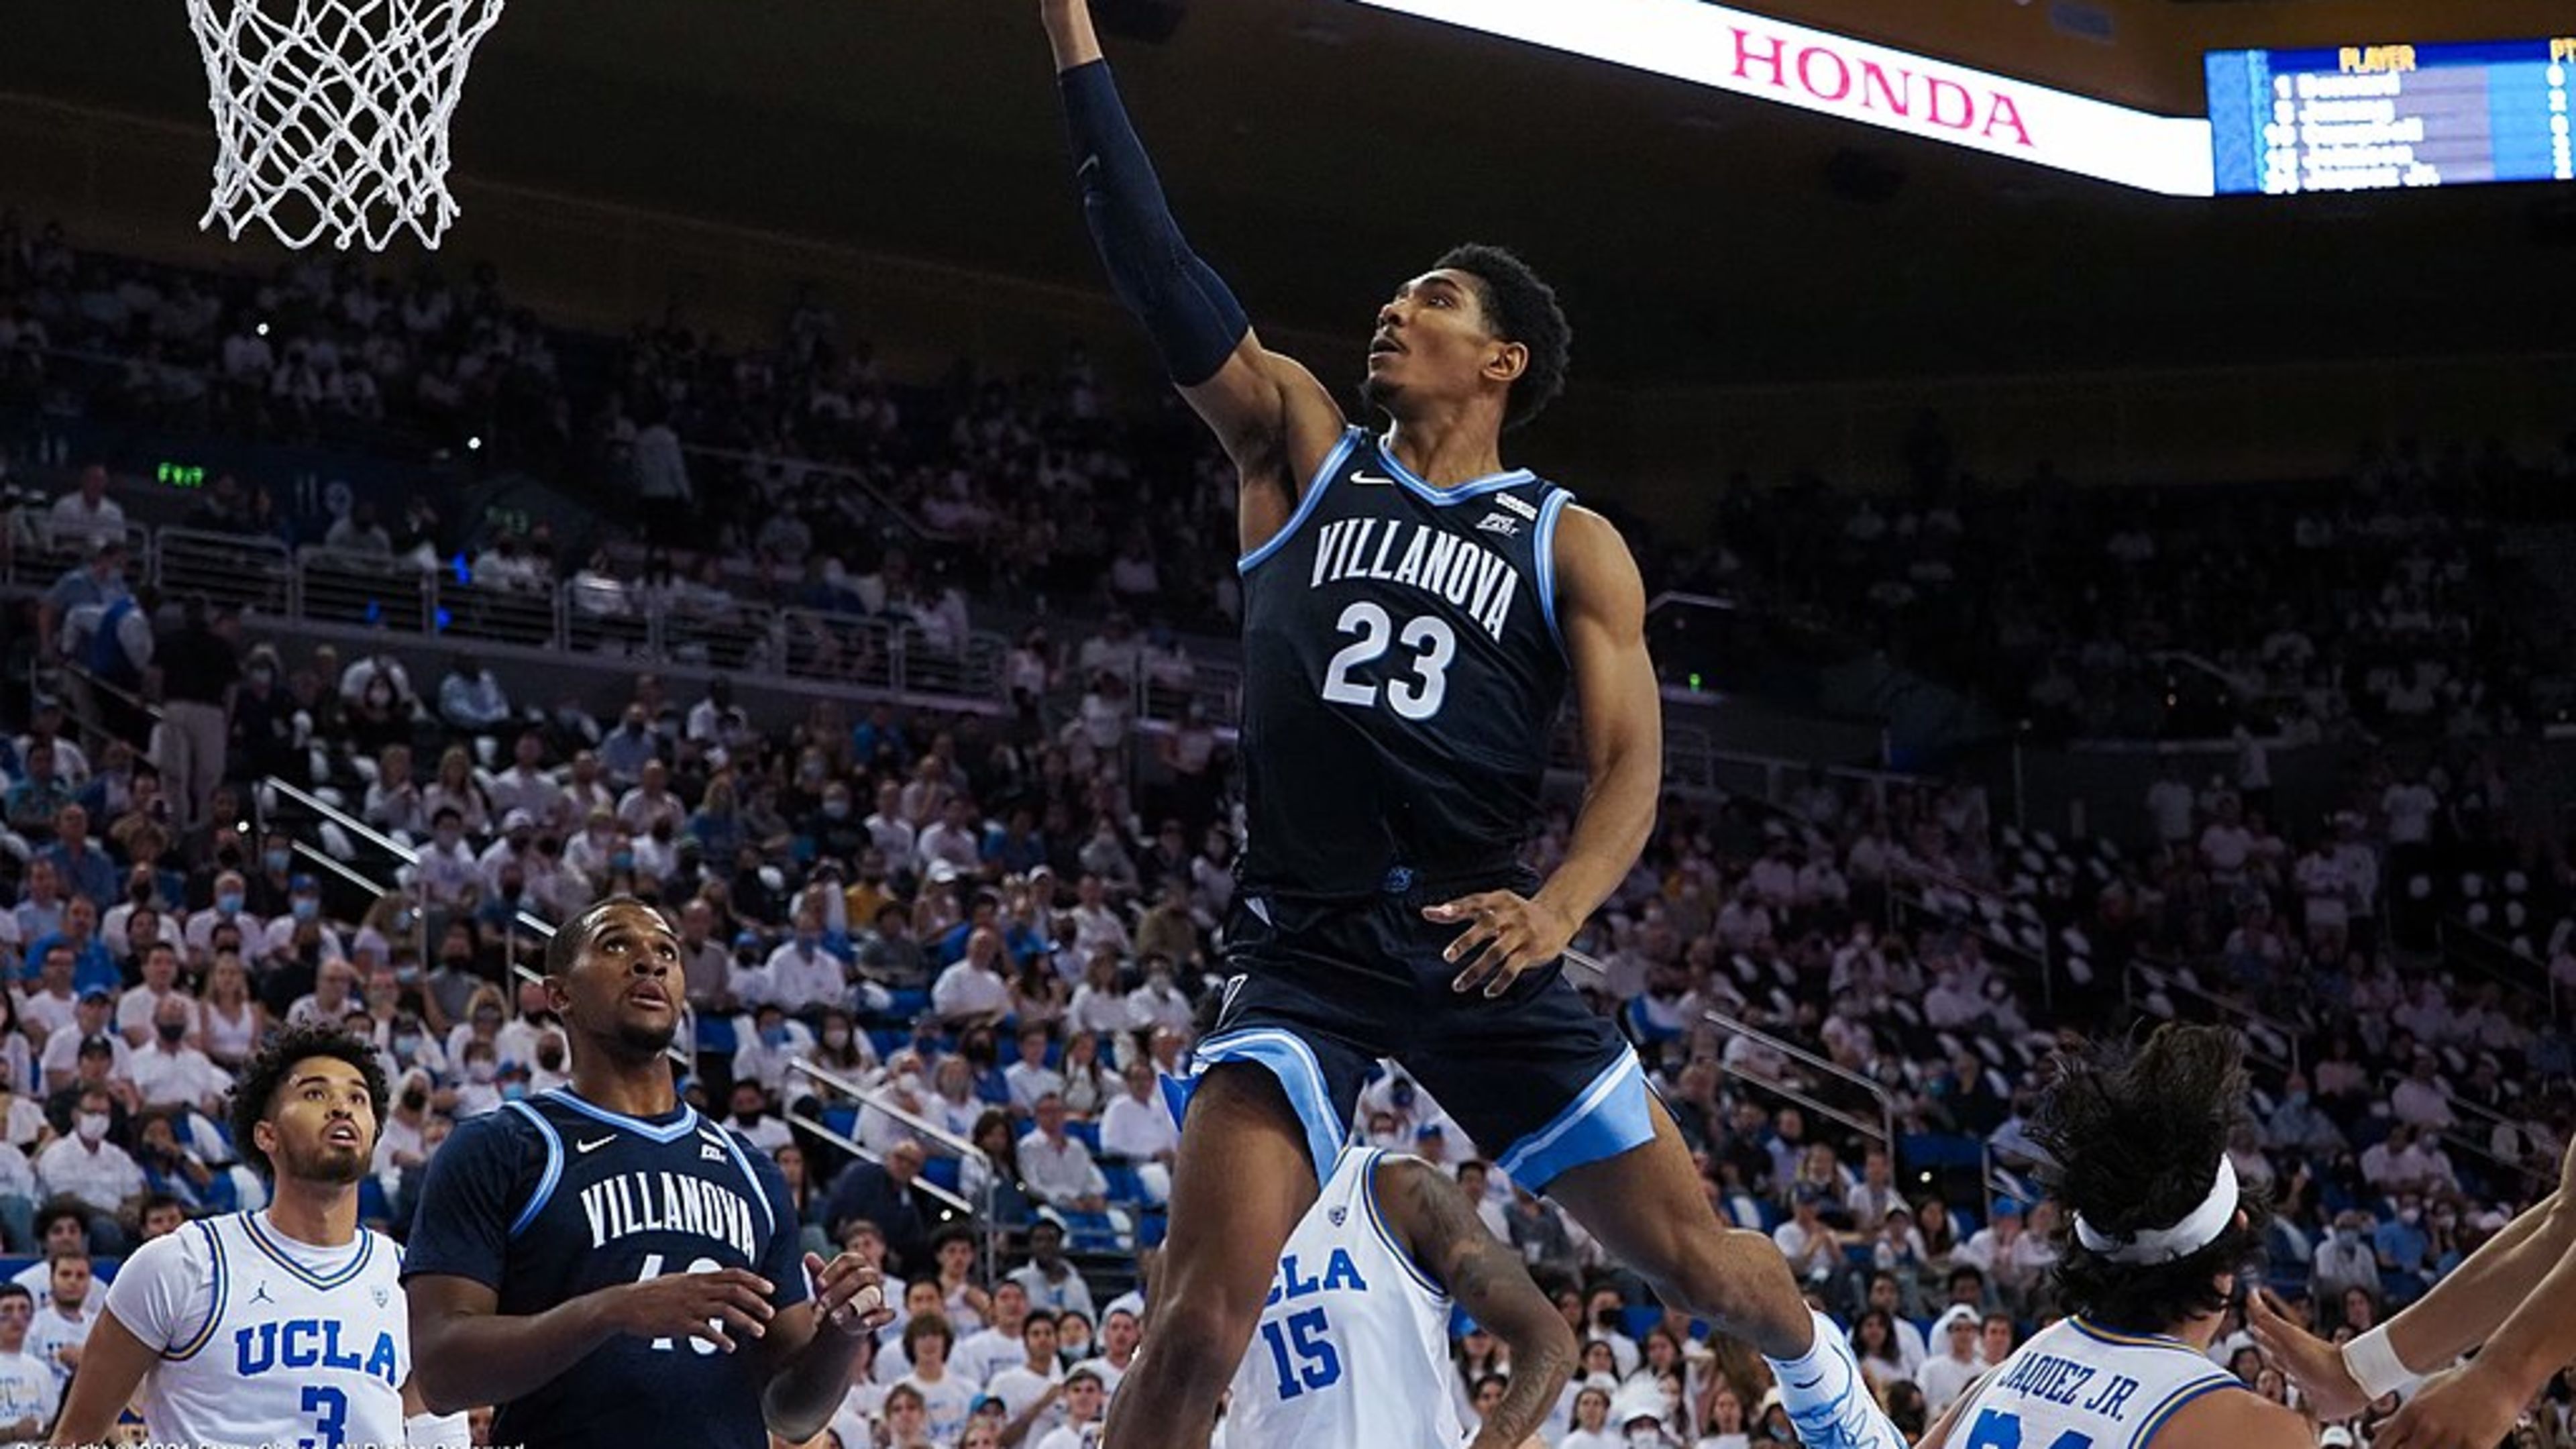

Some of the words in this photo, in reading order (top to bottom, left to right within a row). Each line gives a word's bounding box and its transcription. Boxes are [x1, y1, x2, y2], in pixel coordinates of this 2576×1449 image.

[1728, 27, 2035, 147] HONDA
[1310, 517, 1519, 645] VILLANOVA
[1322, 600, 1456, 721] 23
[580, 1171, 756, 1266] VILLANOVA
[235, 1318, 397, 1385] UCLA
[1261, 1306, 1342, 1400] 15
[1997, 1350, 2097, 1405] JAQUEZ
[2084, 1374, 2139, 1422] JR.
[298, 1385, 350, 1449] 3
